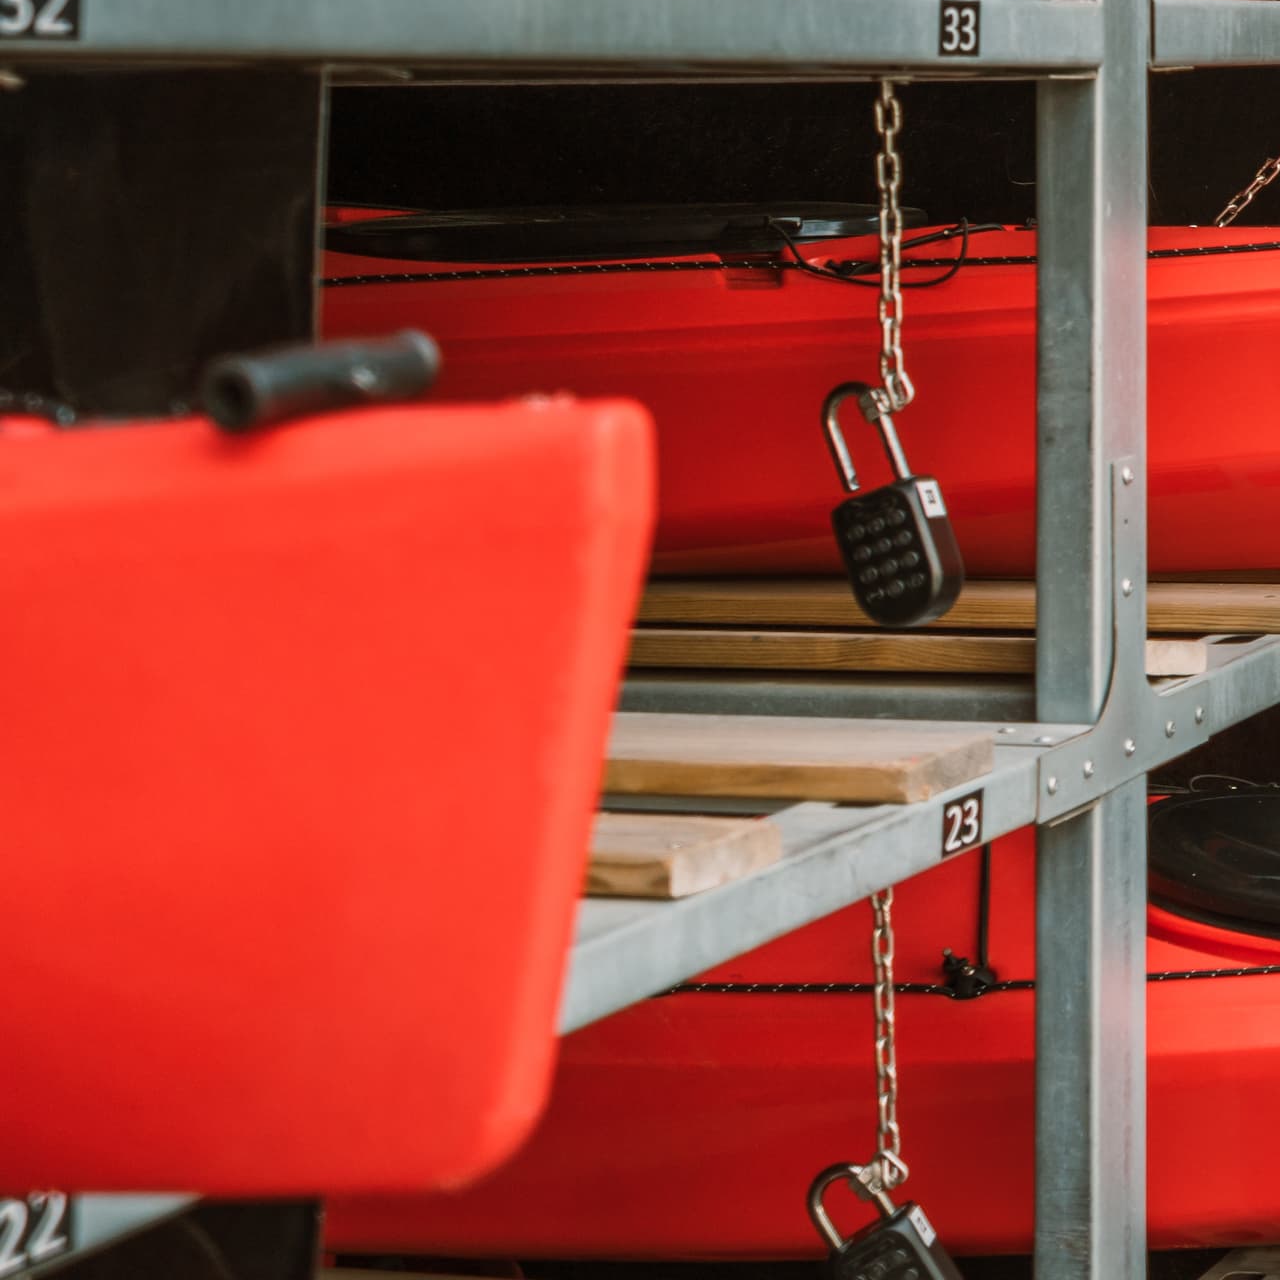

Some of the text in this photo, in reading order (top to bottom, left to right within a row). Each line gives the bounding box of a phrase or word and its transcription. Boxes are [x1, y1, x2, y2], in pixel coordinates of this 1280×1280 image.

[942, 6, 977, 52] 33
[945, 798, 979, 852] 23
[0, 1190, 67, 1276] 22
